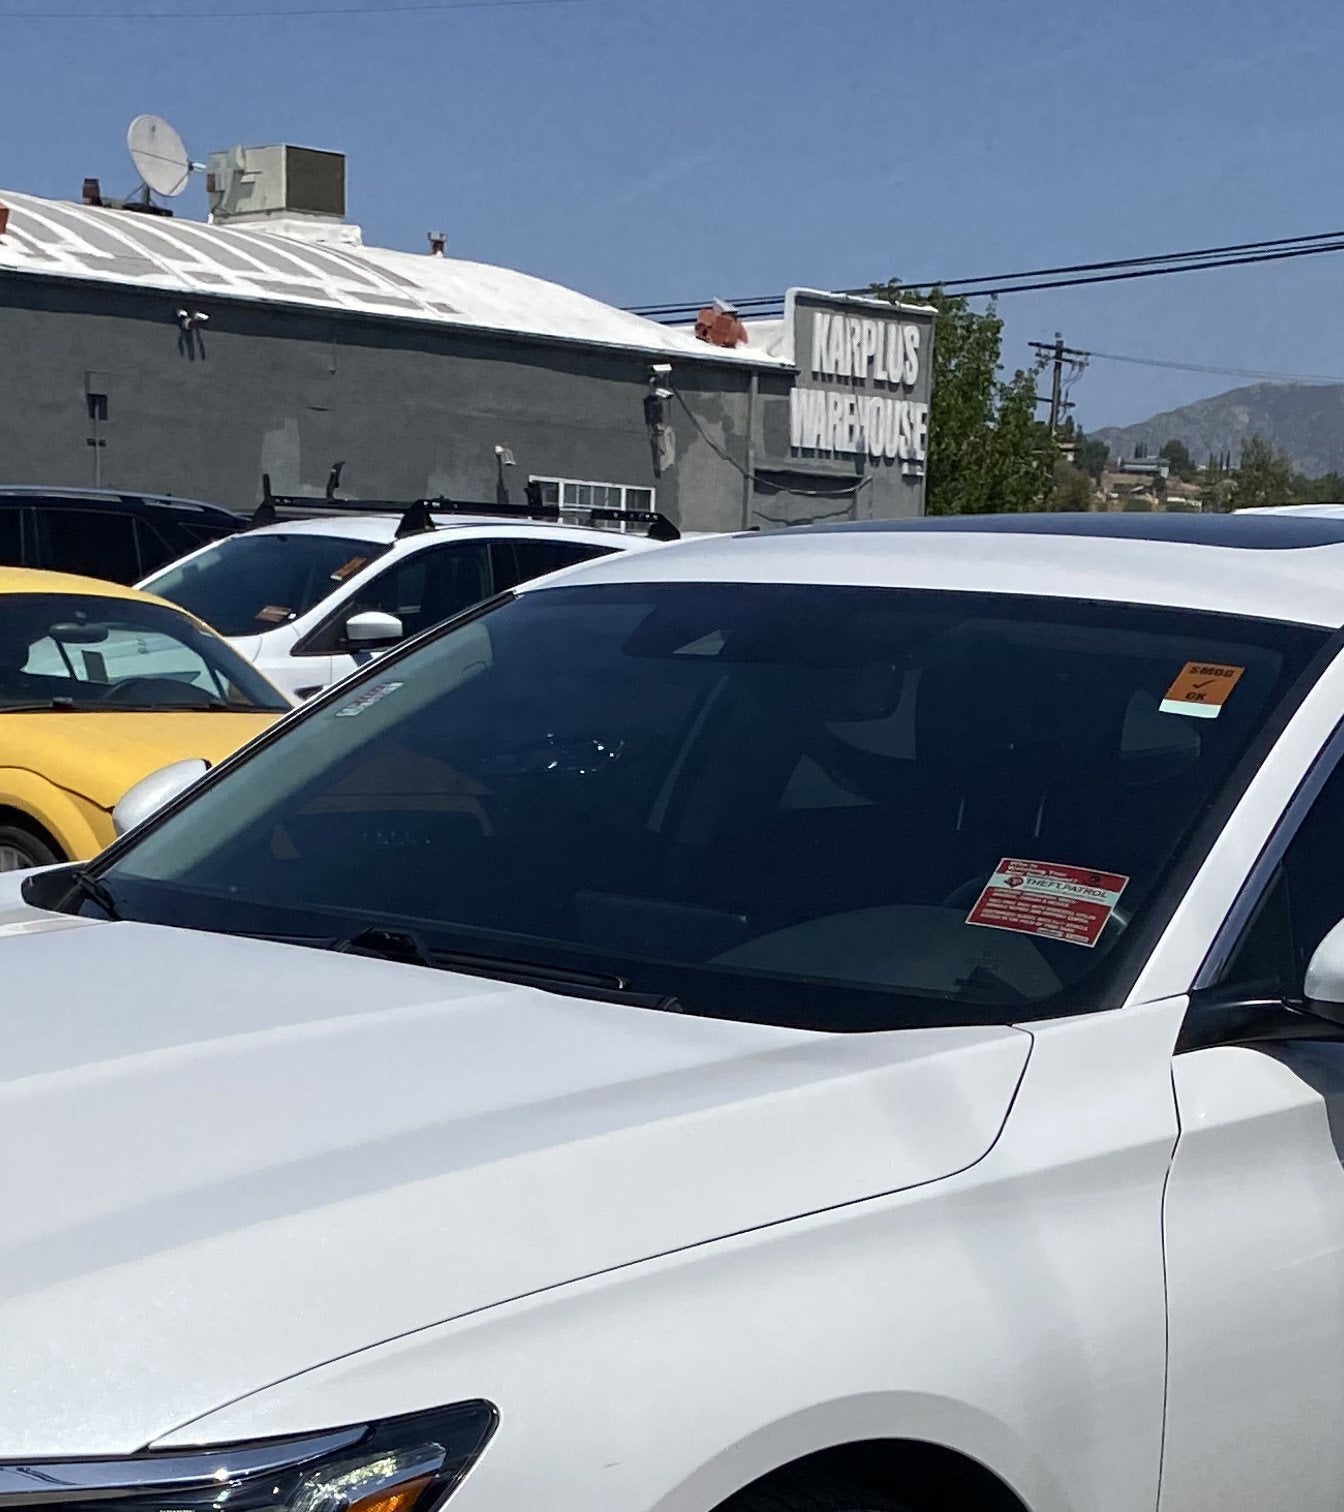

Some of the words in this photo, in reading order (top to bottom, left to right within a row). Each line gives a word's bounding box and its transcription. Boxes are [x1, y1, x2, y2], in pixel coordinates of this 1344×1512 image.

[812, 312, 920, 385] KARPLUS
[790, 388, 927, 460] WAREHOUSE
[1189, 666, 1235, 678] SMOG
